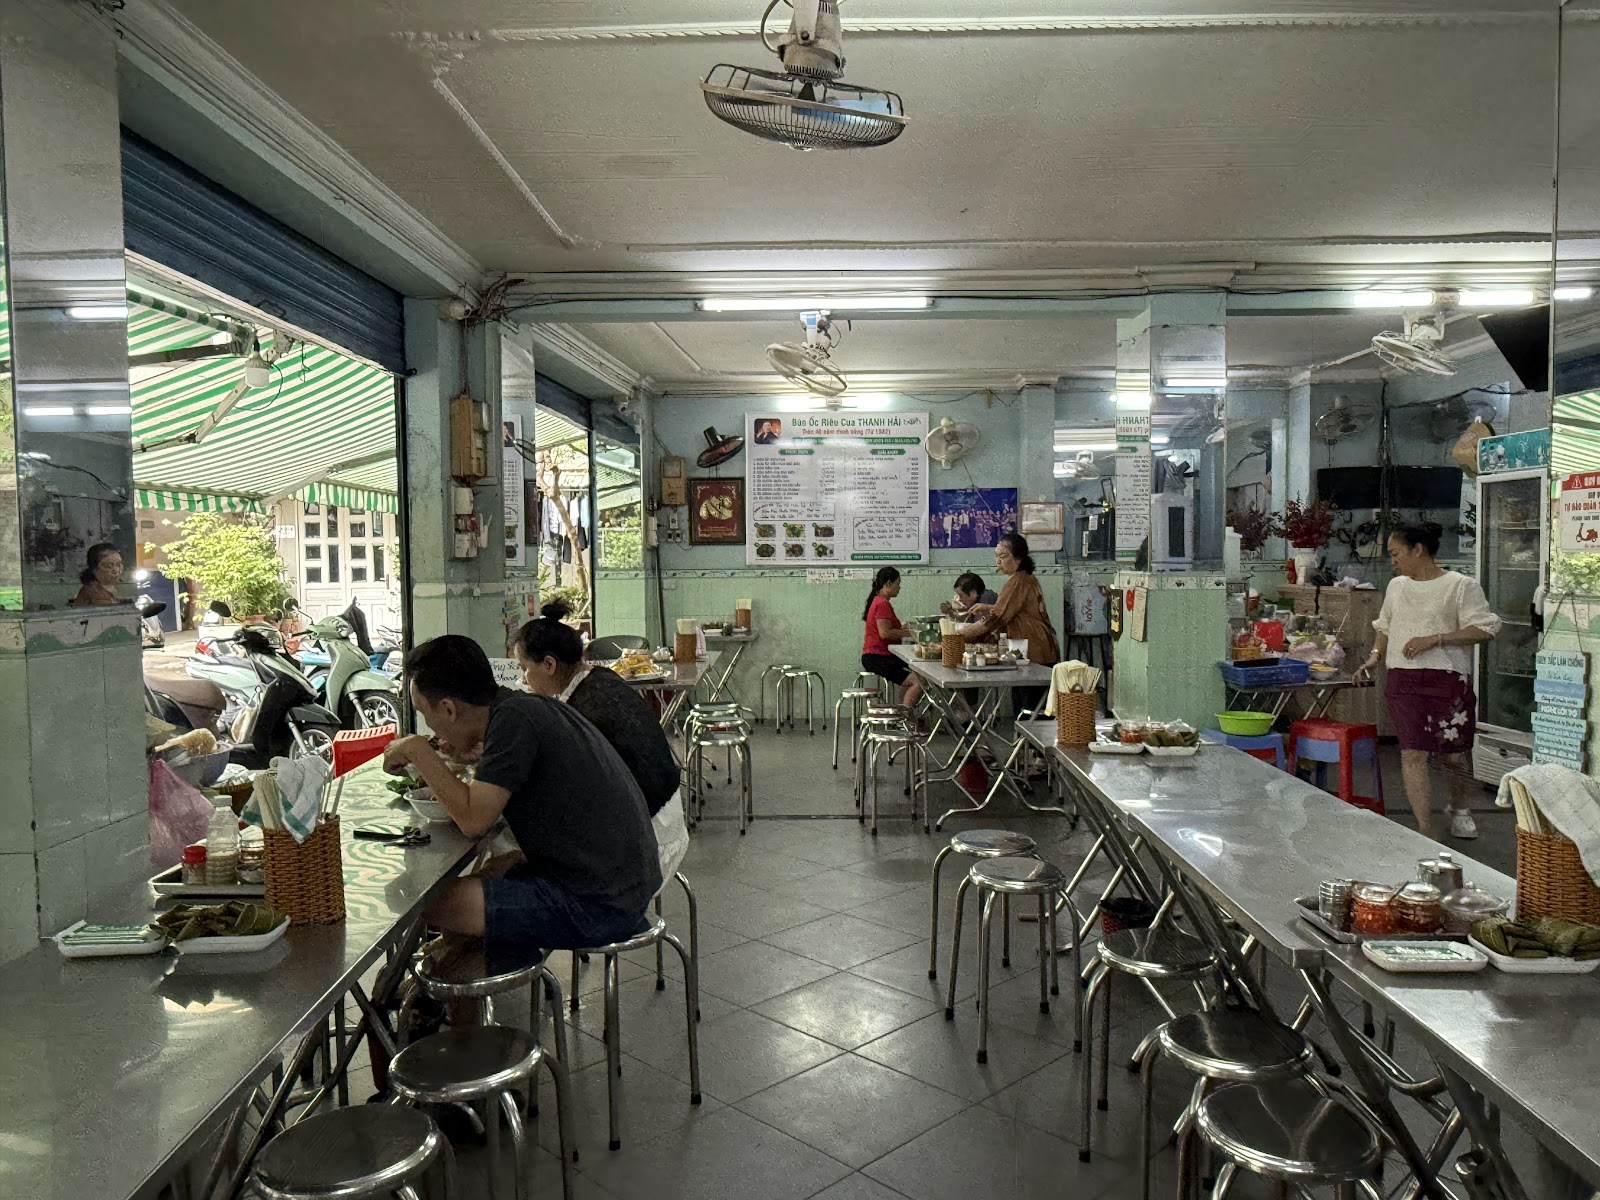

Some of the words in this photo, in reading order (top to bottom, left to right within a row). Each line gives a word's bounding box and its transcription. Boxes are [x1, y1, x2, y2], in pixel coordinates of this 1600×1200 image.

[841, 418, 855, 427] Cua
[858, 418, 885, 427] THANH
[887, 416, 901, 427] HẢI
